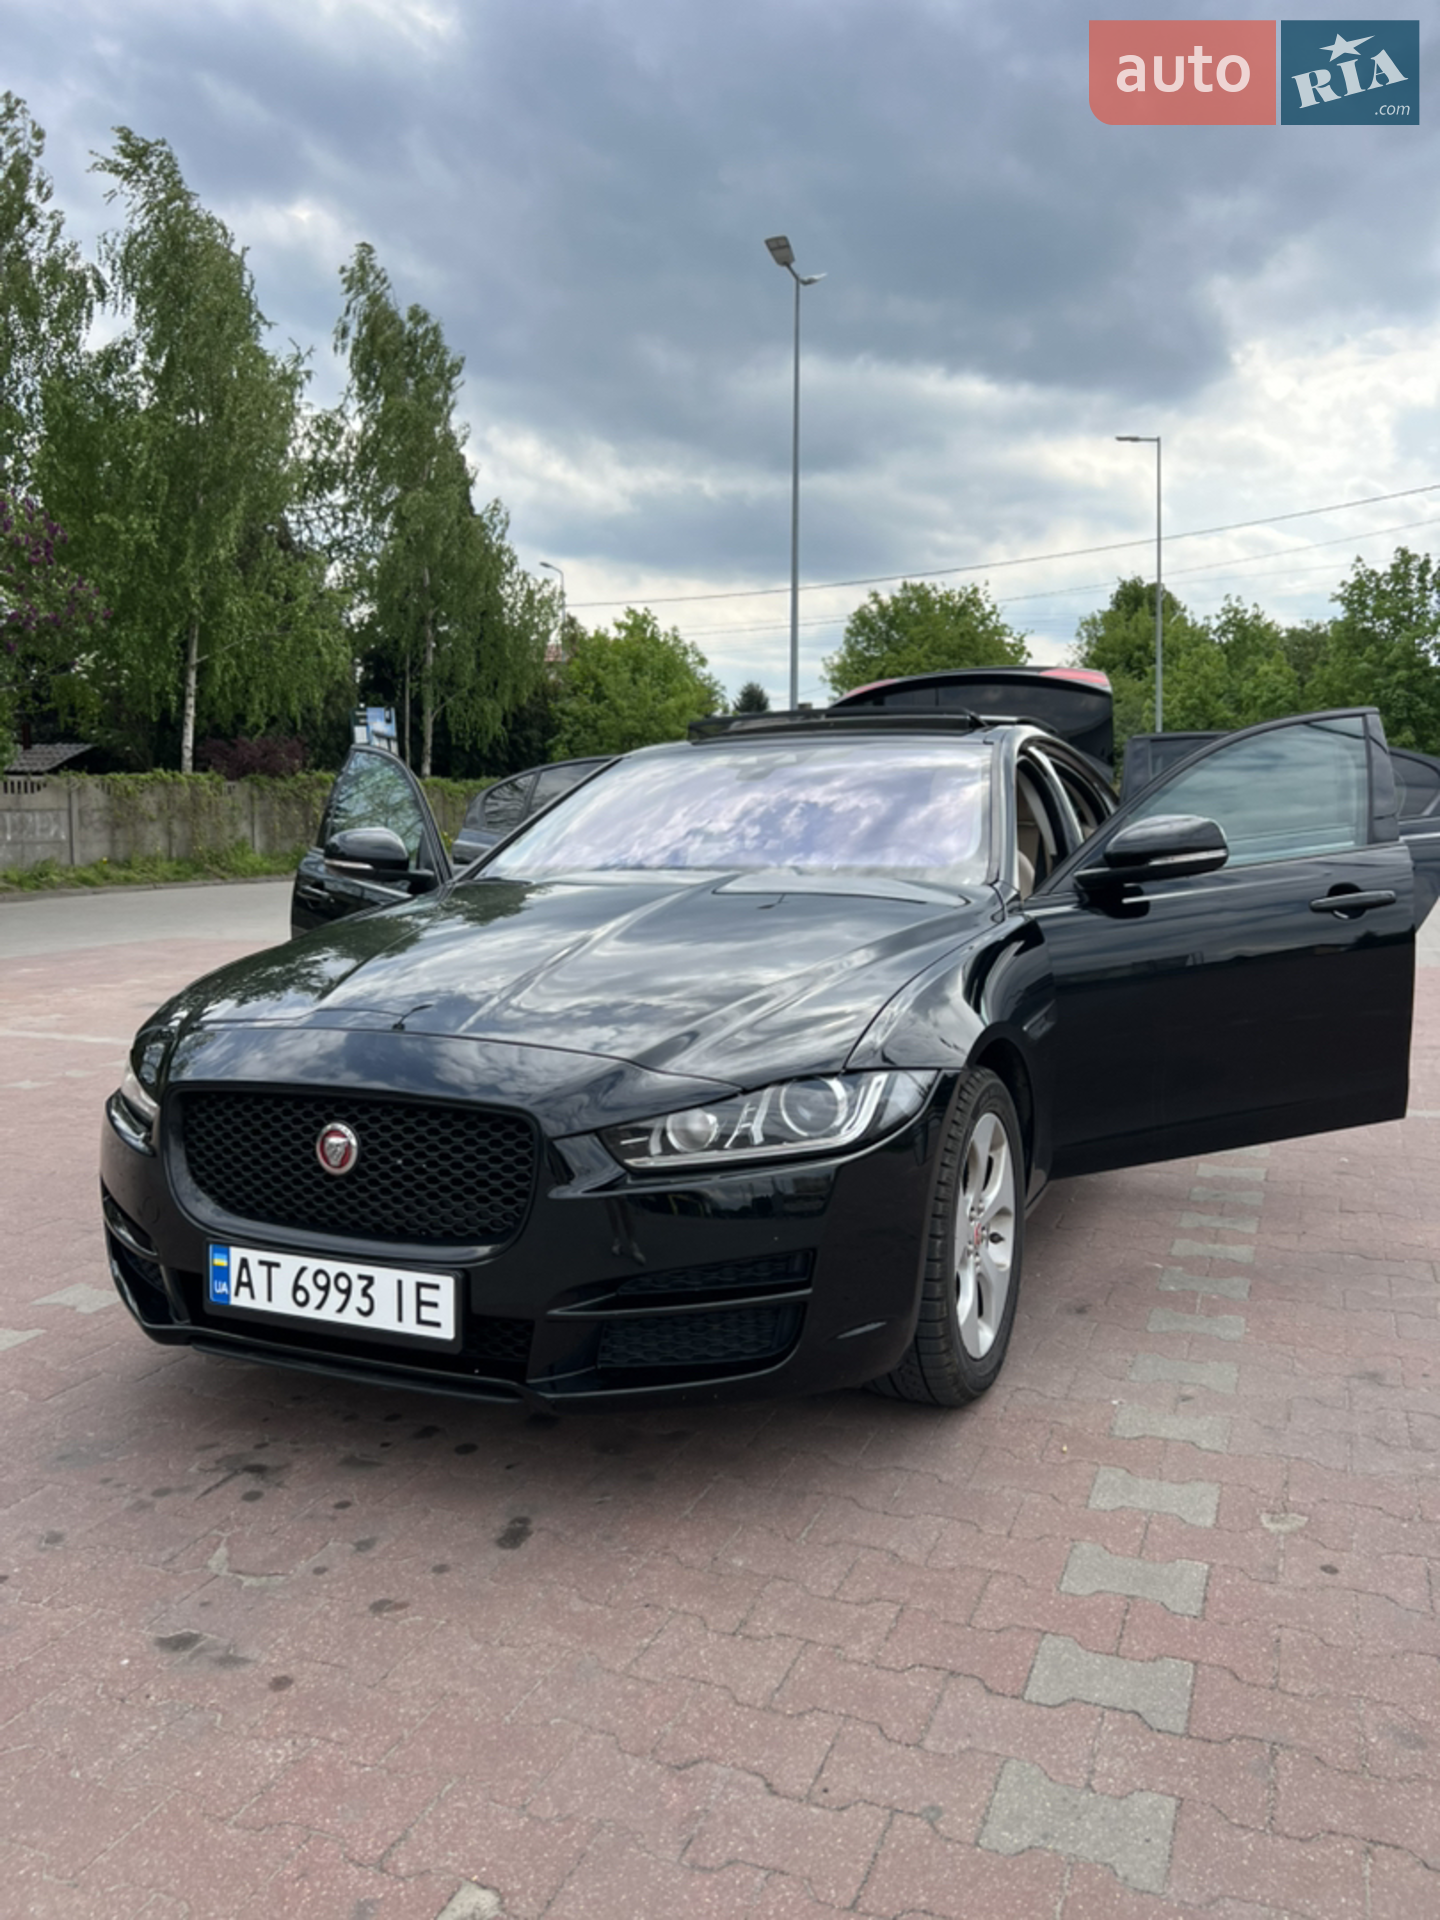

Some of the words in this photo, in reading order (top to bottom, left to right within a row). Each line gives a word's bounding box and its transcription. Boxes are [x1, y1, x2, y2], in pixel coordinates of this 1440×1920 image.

[214, 1280, 229, 1295] UA
[234, 1257, 281, 1303] AT
[291, 1266, 375, 1317] 6993
[397, 1279, 442, 1328] IE
